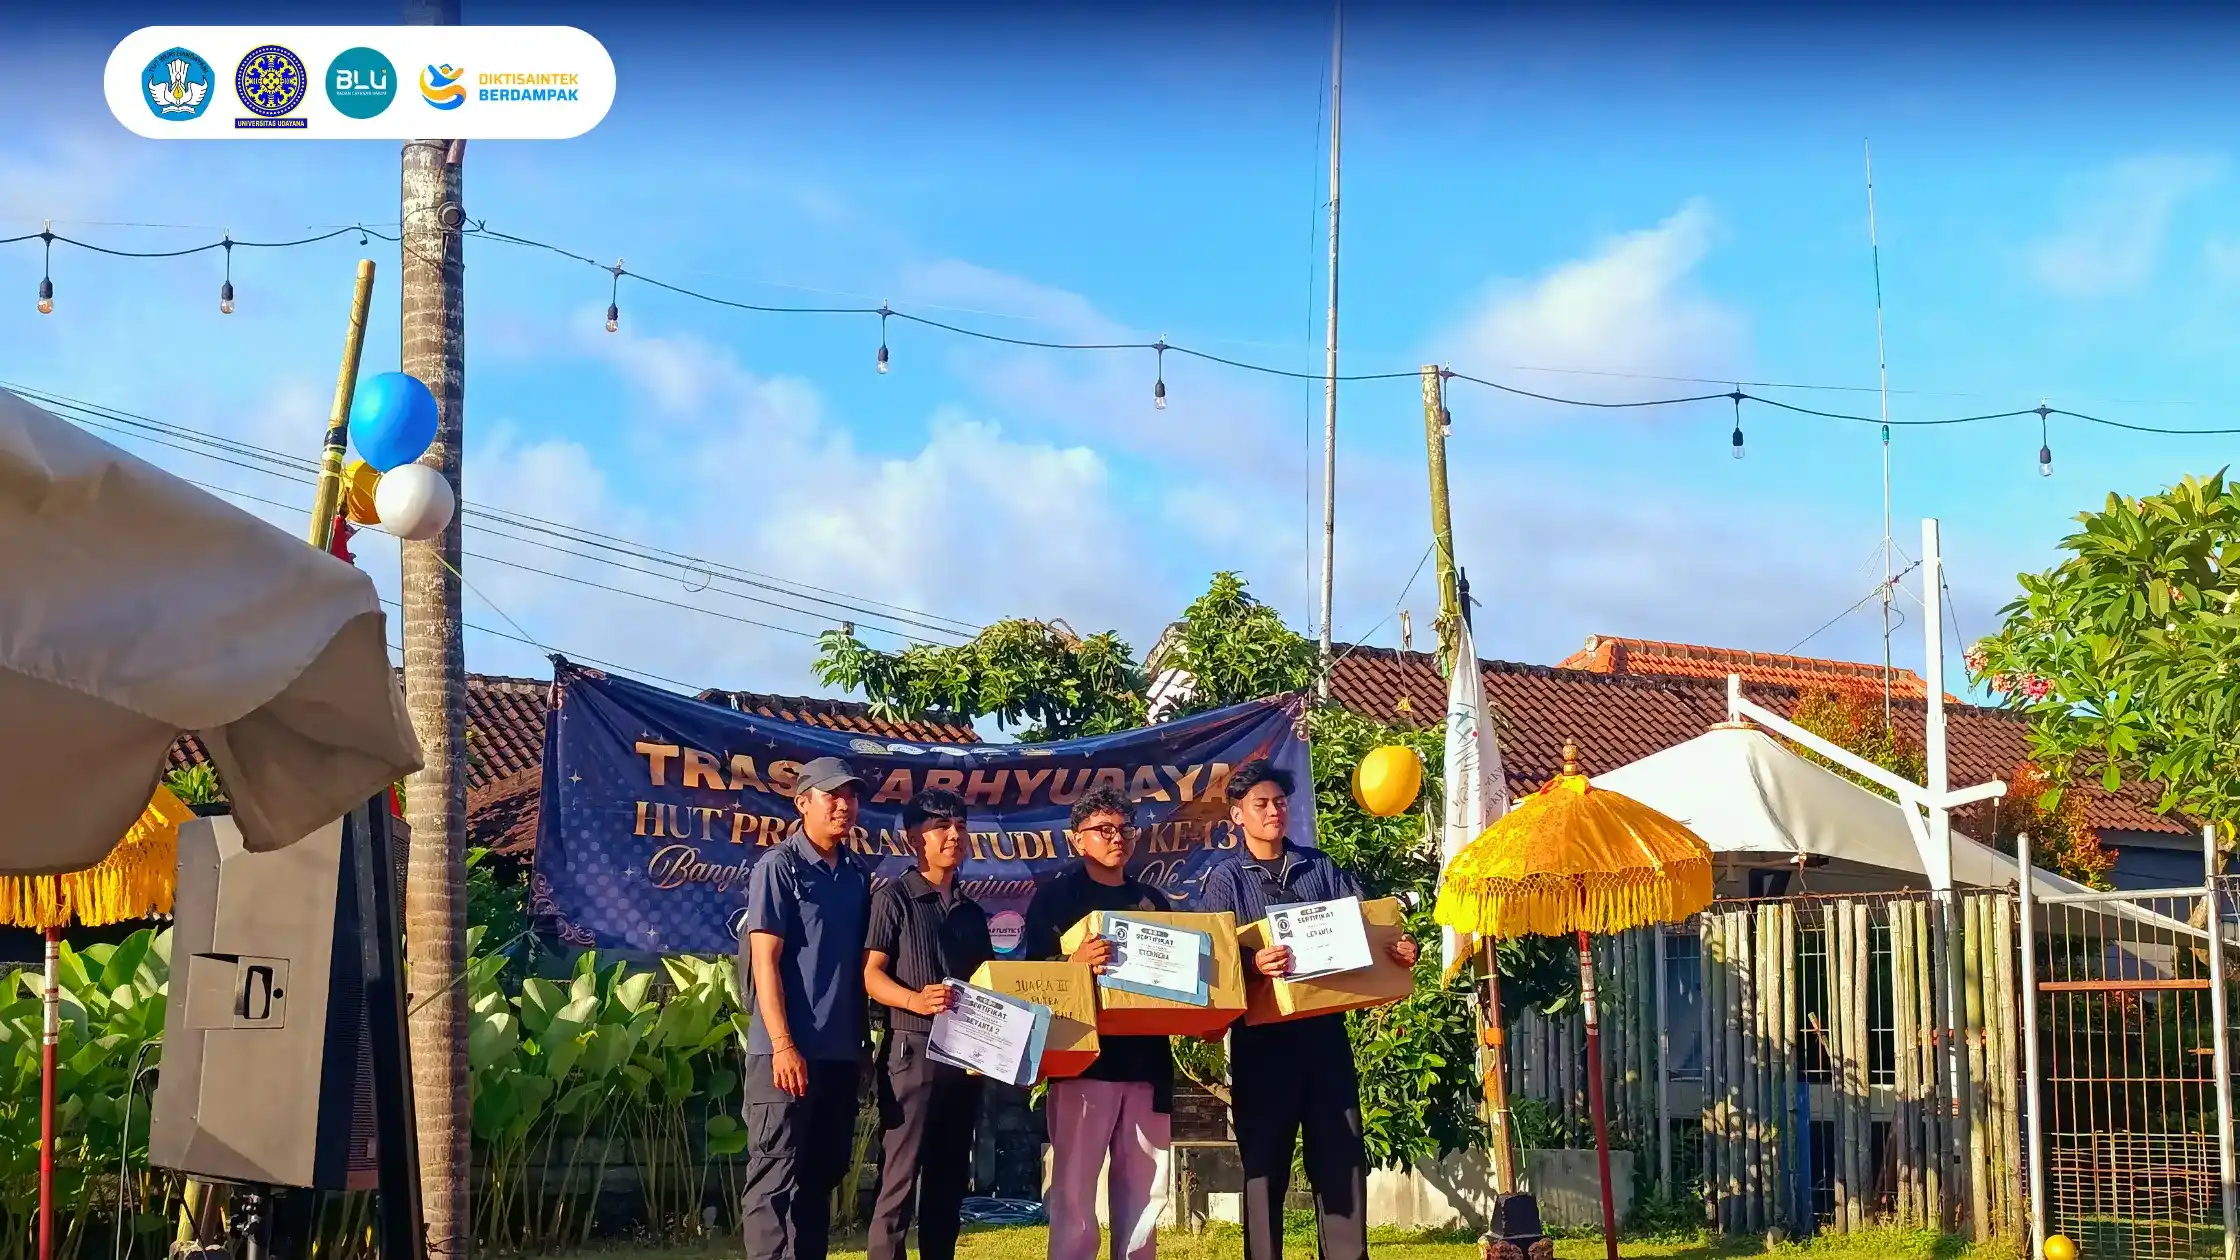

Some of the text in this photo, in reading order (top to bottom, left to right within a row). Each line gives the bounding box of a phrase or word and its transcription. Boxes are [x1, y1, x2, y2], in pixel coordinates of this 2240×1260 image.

[635, 741, 804, 798] TRAS
[633, 801, 723, 842] HUT
[967, 829, 1058, 861] TUDI
[1148, 819, 1238, 854] KE-13
[648, 844, 752, 893] Bangk
[1297, 911, 1334, 924] SERTIFIKAT
[1136, 933, 1174, 946] SERTIFIKAT
[1015, 979, 1053, 992] JUARA
[969, 1000, 1008, 1020] SERTIFIKAT
